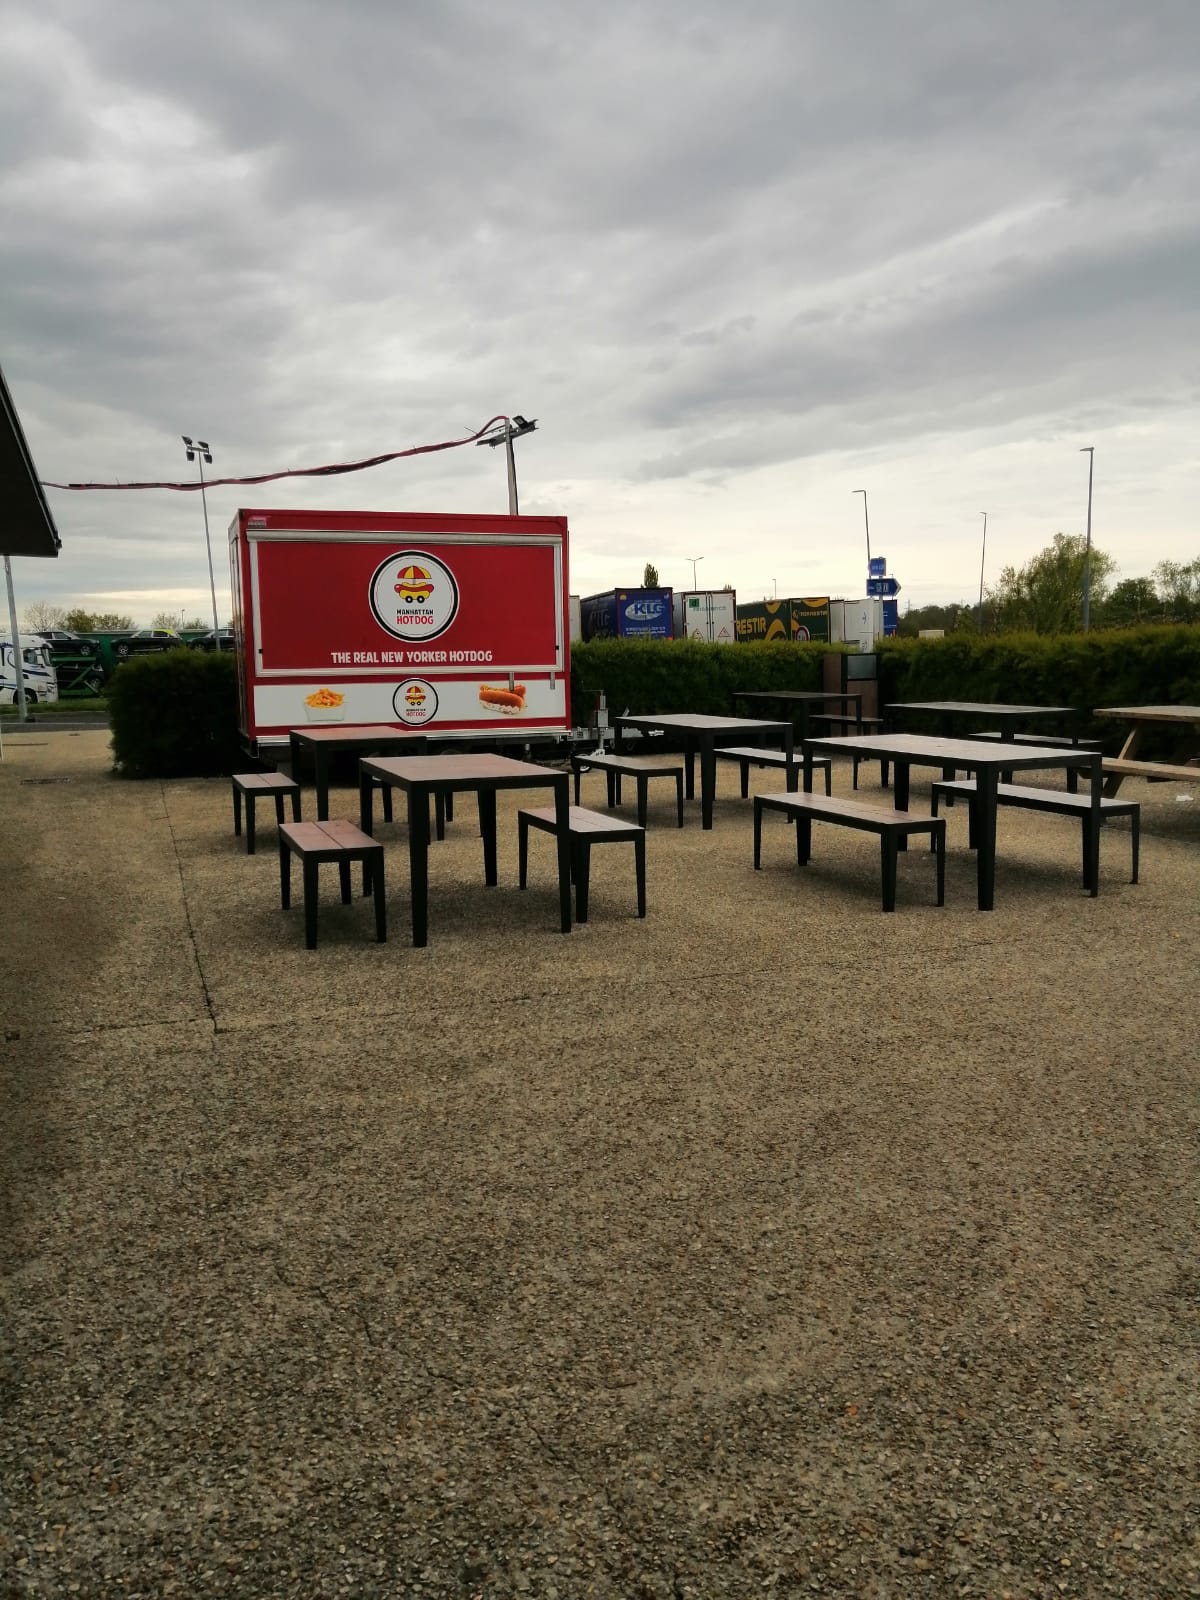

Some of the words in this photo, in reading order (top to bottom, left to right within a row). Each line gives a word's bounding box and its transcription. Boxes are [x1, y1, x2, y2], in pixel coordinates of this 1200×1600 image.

[331, 652, 351, 664] THE
[353, 652, 379, 664] REAL
[381, 651, 404, 663] NEW
[406, 651, 447, 663] YORKER
[449, 650, 493, 662] HOTDOG
